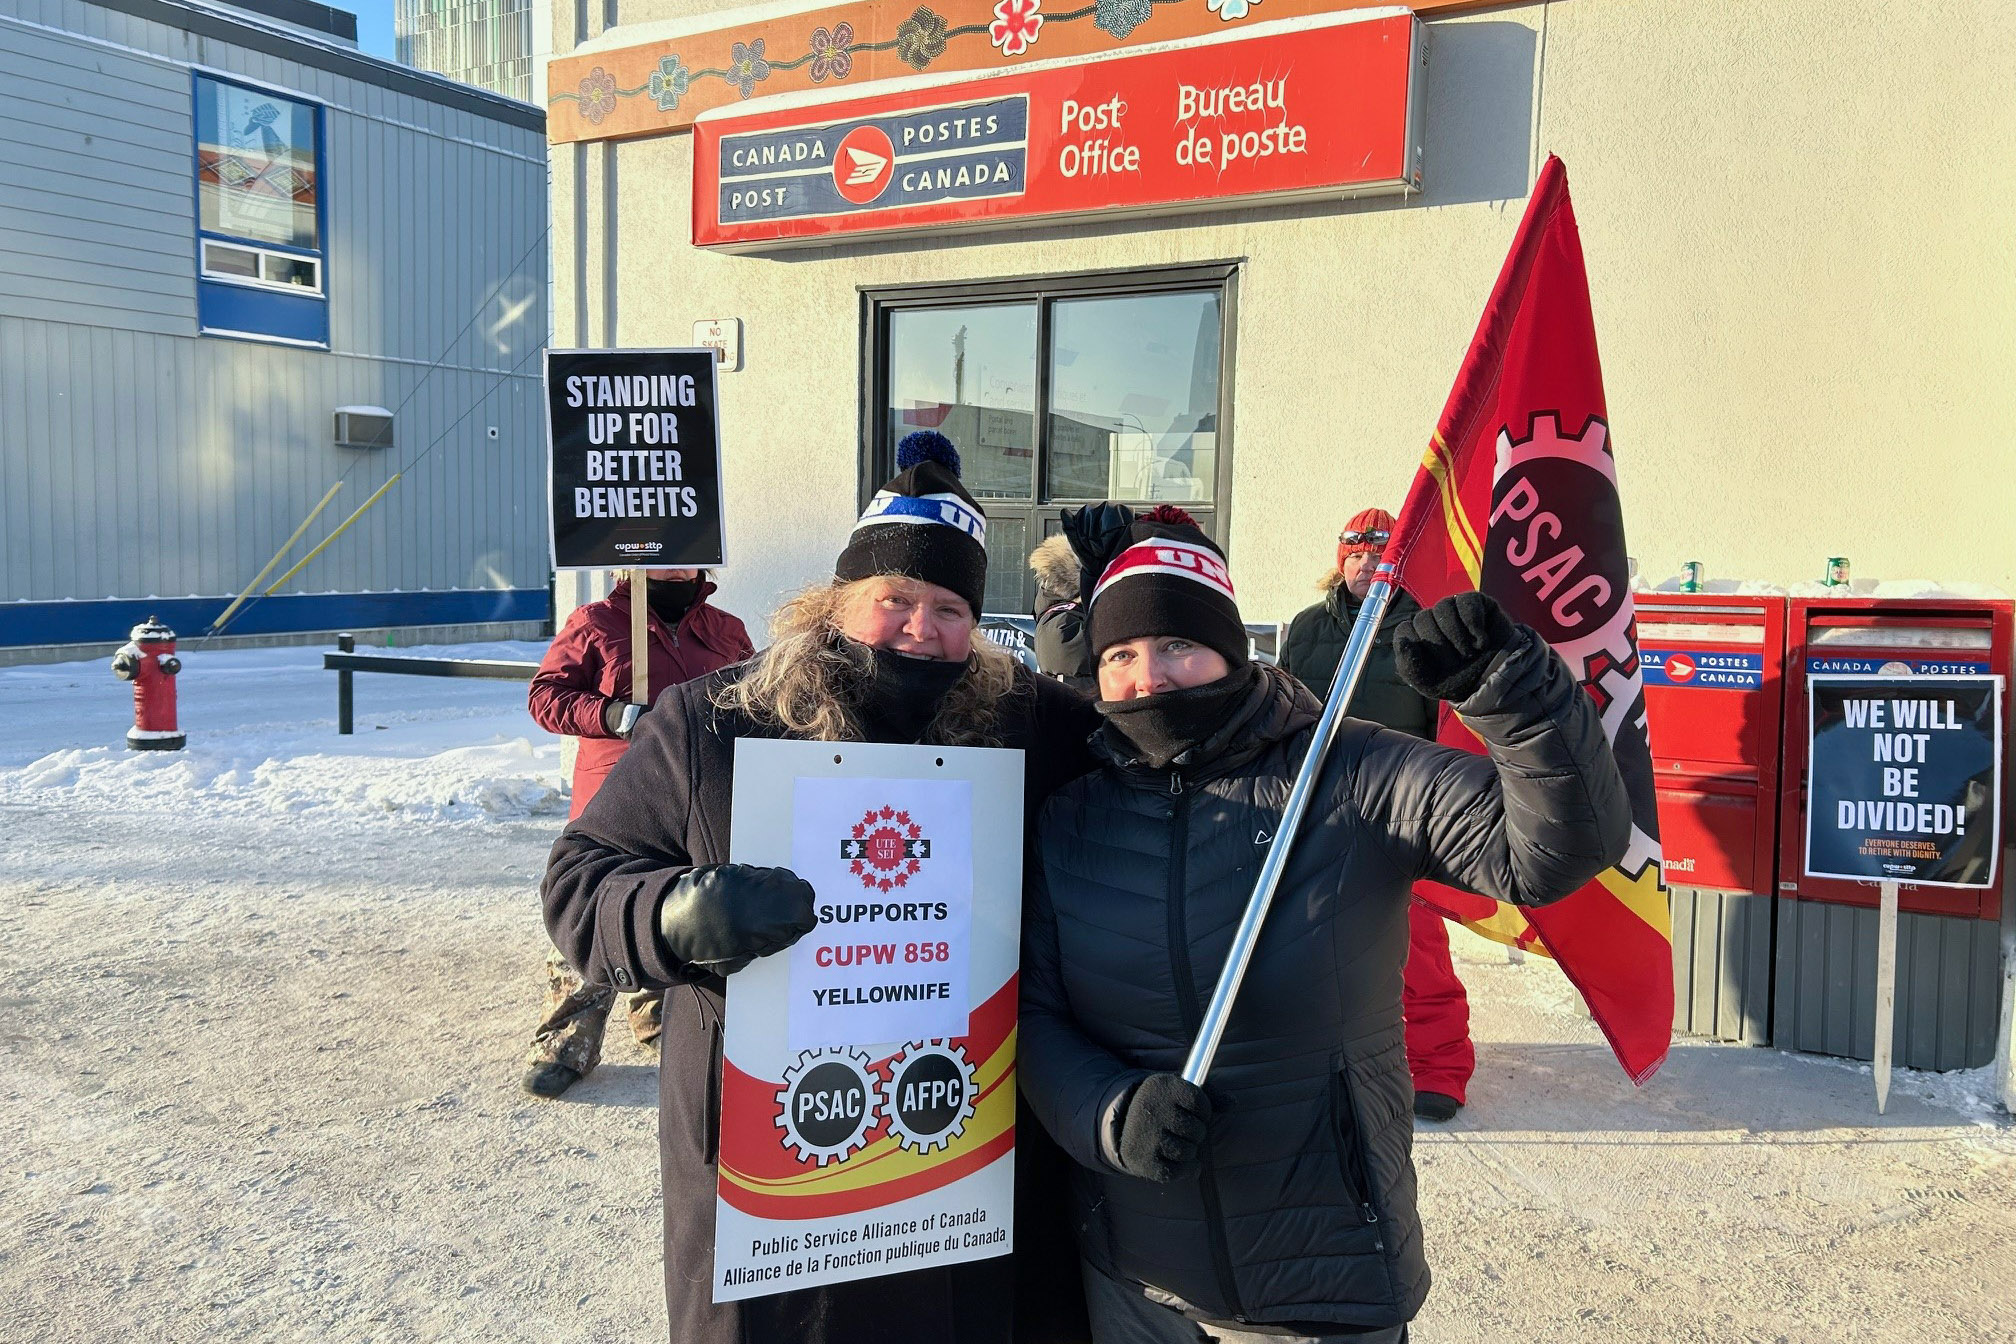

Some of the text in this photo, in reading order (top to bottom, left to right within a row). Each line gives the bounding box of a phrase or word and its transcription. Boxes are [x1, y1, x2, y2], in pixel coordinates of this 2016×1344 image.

[1061, 94, 1121, 135] Post
[1178, 81, 1285, 119] Bureau
[903, 115, 998, 146] POSTES
[1176, 122, 1306, 170] de poste
[733, 140, 826, 168] CANADA
[1060, 139, 1139, 178] Office
[903, 161, 1010, 192] CANADA
[732, 187, 787, 210] POST
[709, 327, 721, 337] NO
[566, 374, 696, 408] STANDING
[588, 412, 678, 444] UP FOR
[586, 450, 682, 481] BETTER
[574, 486, 698, 518] BENEFITS
[1488, 476, 1612, 628] PSAC
[981, 628, 1026, 648] EALTH &
[1701, 657, 1748, 667] POSTES
[1813, 661, 1976, 674] CANADA POSTES
[1700, 673, 1754, 684] CANADA
[1843, 699, 1963, 730] WE WILL
[1873, 733, 1930, 763] NOT
[1883, 767, 1919, 798] BE
[1838, 800, 1966, 835] DIVIDED!
[876, 838, 896, 849] UTE
[877, 850, 895, 860] SEI
[1859, 847, 1867, 855] TO
[1868, 847, 1892, 856] RETIRE
[1893, 849, 1911, 857] WITH
[1865, 839, 1936, 851] EVERYONE DESERVES
[819, 902, 948, 924] SUPPORTS
[816, 942, 950, 968] CUPW 858
[813, 983, 950, 1006] YELLOWNIFE
[798, 1088, 861, 1123] PSAC
[902, 1078, 960, 1113] AFPC
[752, 1207, 986, 1257] Public Service Alliance of Canada
[723, 1227, 1006, 1286] Alliance de la Fonction publique du Canada
